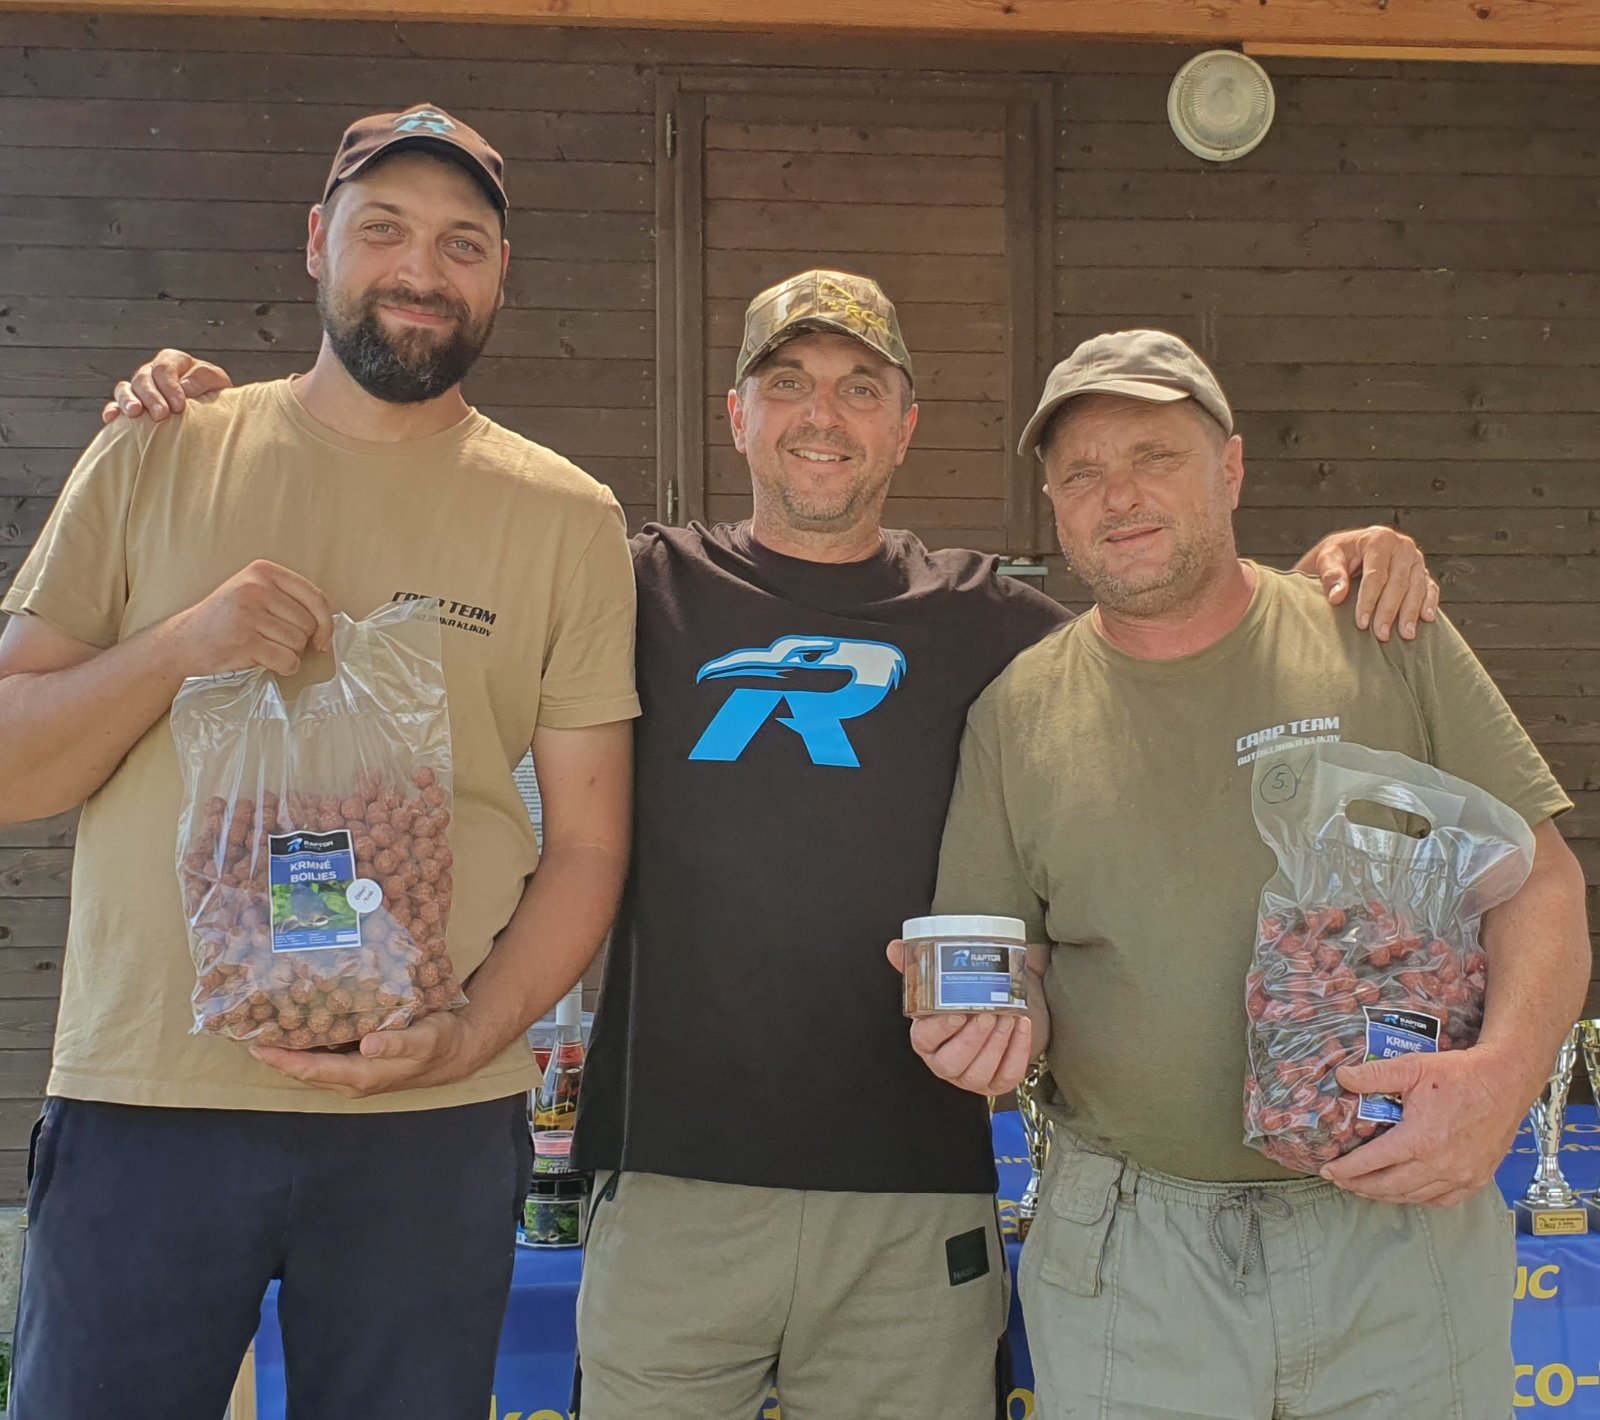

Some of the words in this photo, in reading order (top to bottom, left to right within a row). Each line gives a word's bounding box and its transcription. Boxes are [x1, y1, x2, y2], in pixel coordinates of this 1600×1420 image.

[449, 600, 497, 625] TEAM
[456, 621, 494, 637] KLIKOV
[1236, 724, 1285, 752] CARP
[1288, 716, 1340, 735] TEAM
[303, 840, 334, 848] RAPTOR
[290, 860, 332, 872] KRMNÉ
[290, 871, 337, 883] BOILIES
[970, 953, 1001, 962] RAPTOR
[1385, 1035, 1422, 1052] KRMNÉ
